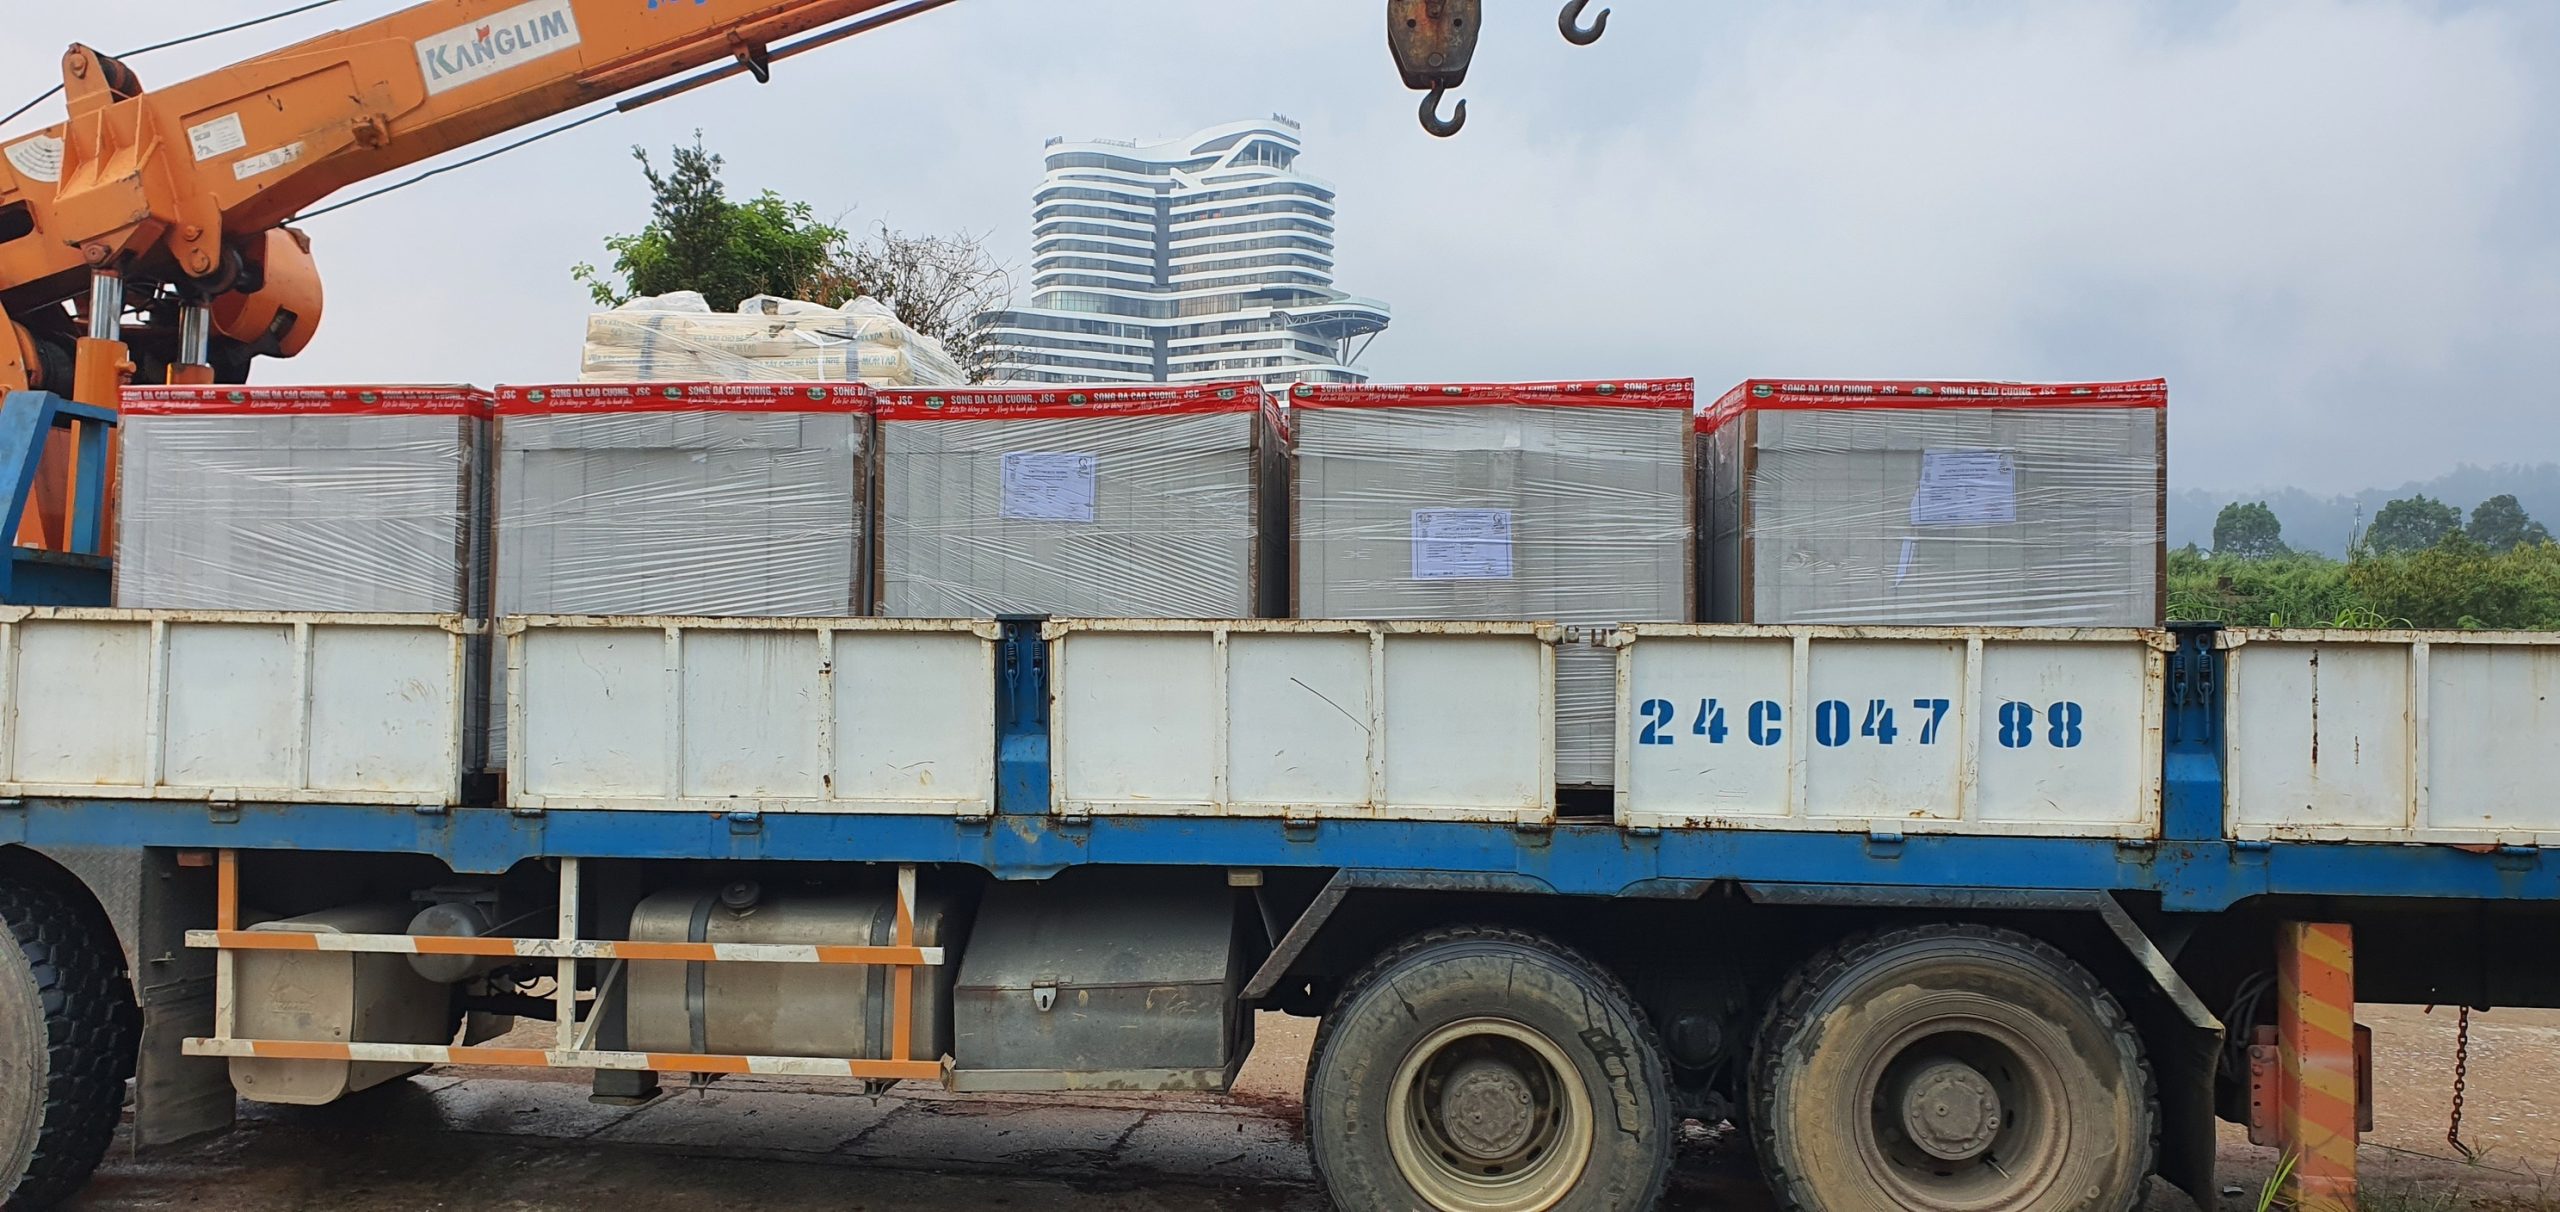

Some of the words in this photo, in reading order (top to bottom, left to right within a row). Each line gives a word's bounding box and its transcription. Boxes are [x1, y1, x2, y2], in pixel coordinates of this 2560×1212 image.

[425, 10, 569, 80] KANGLIM
[550, 388, 572, 398] SONG
[585, 387, 601, 397] CAO
[635, 386, 651, 396] JSC
[688, 385, 711, 396] SONG
[725, 386, 742, 395] CAO
[778, 386, 795, 396] JSC
[833, 386, 855, 396] SONG
[1880, 385, 1898, 394] JSC
[1940, 386, 1965, 396] SONG
[1981, 387, 1999, 396] CAO
[501, 390, 517, 400] JSC
[897, 395, 913, 405] JSC
[950, 394, 974, 405] SONG
[987, 393, 1004, 404] CAO
[1039, 393, 1056, 403] JSC
[1131, 391, 1147, 400] CAO
[1183, 390, 1200, 399] JSC
[1639, 698, 1782, 746] 24C
[1815, 699, 1950, 748] 047
[1998, 701, 2083, 748] 88
